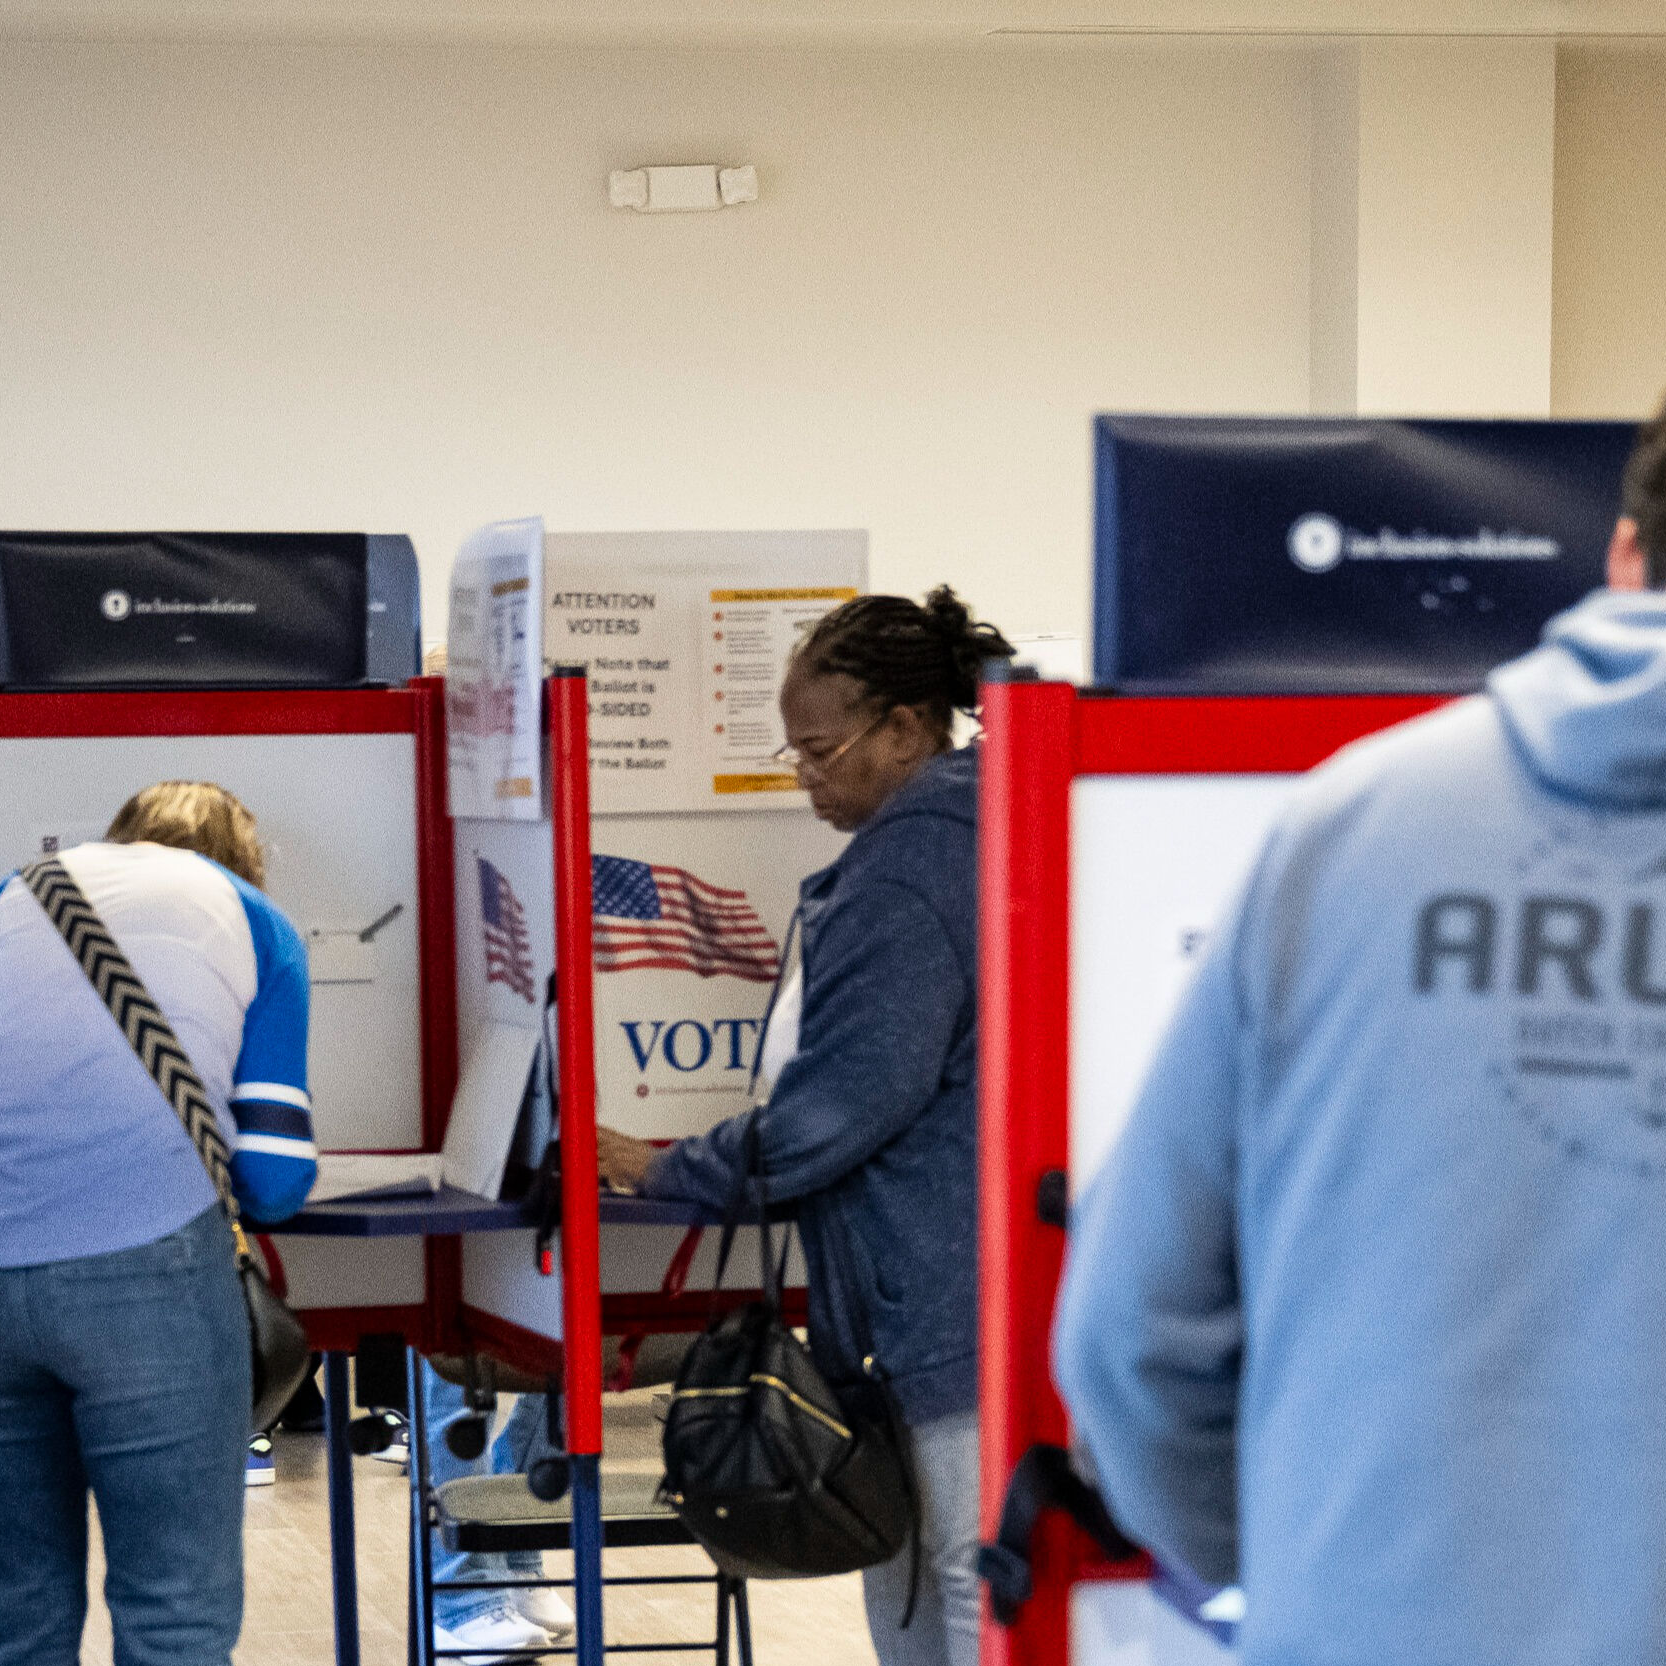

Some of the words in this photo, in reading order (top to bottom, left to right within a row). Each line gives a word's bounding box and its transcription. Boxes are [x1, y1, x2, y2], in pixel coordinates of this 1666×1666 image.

[553, 592, 656, 609] ATTENTION
[568, 619, 640, 635] VOTERS
[595, 658, 633, 670] Note
[637, 658, 669, 670] that
[591, 681, 637, 693] Ballot
[619, 1019, 765, 1072] VOT
